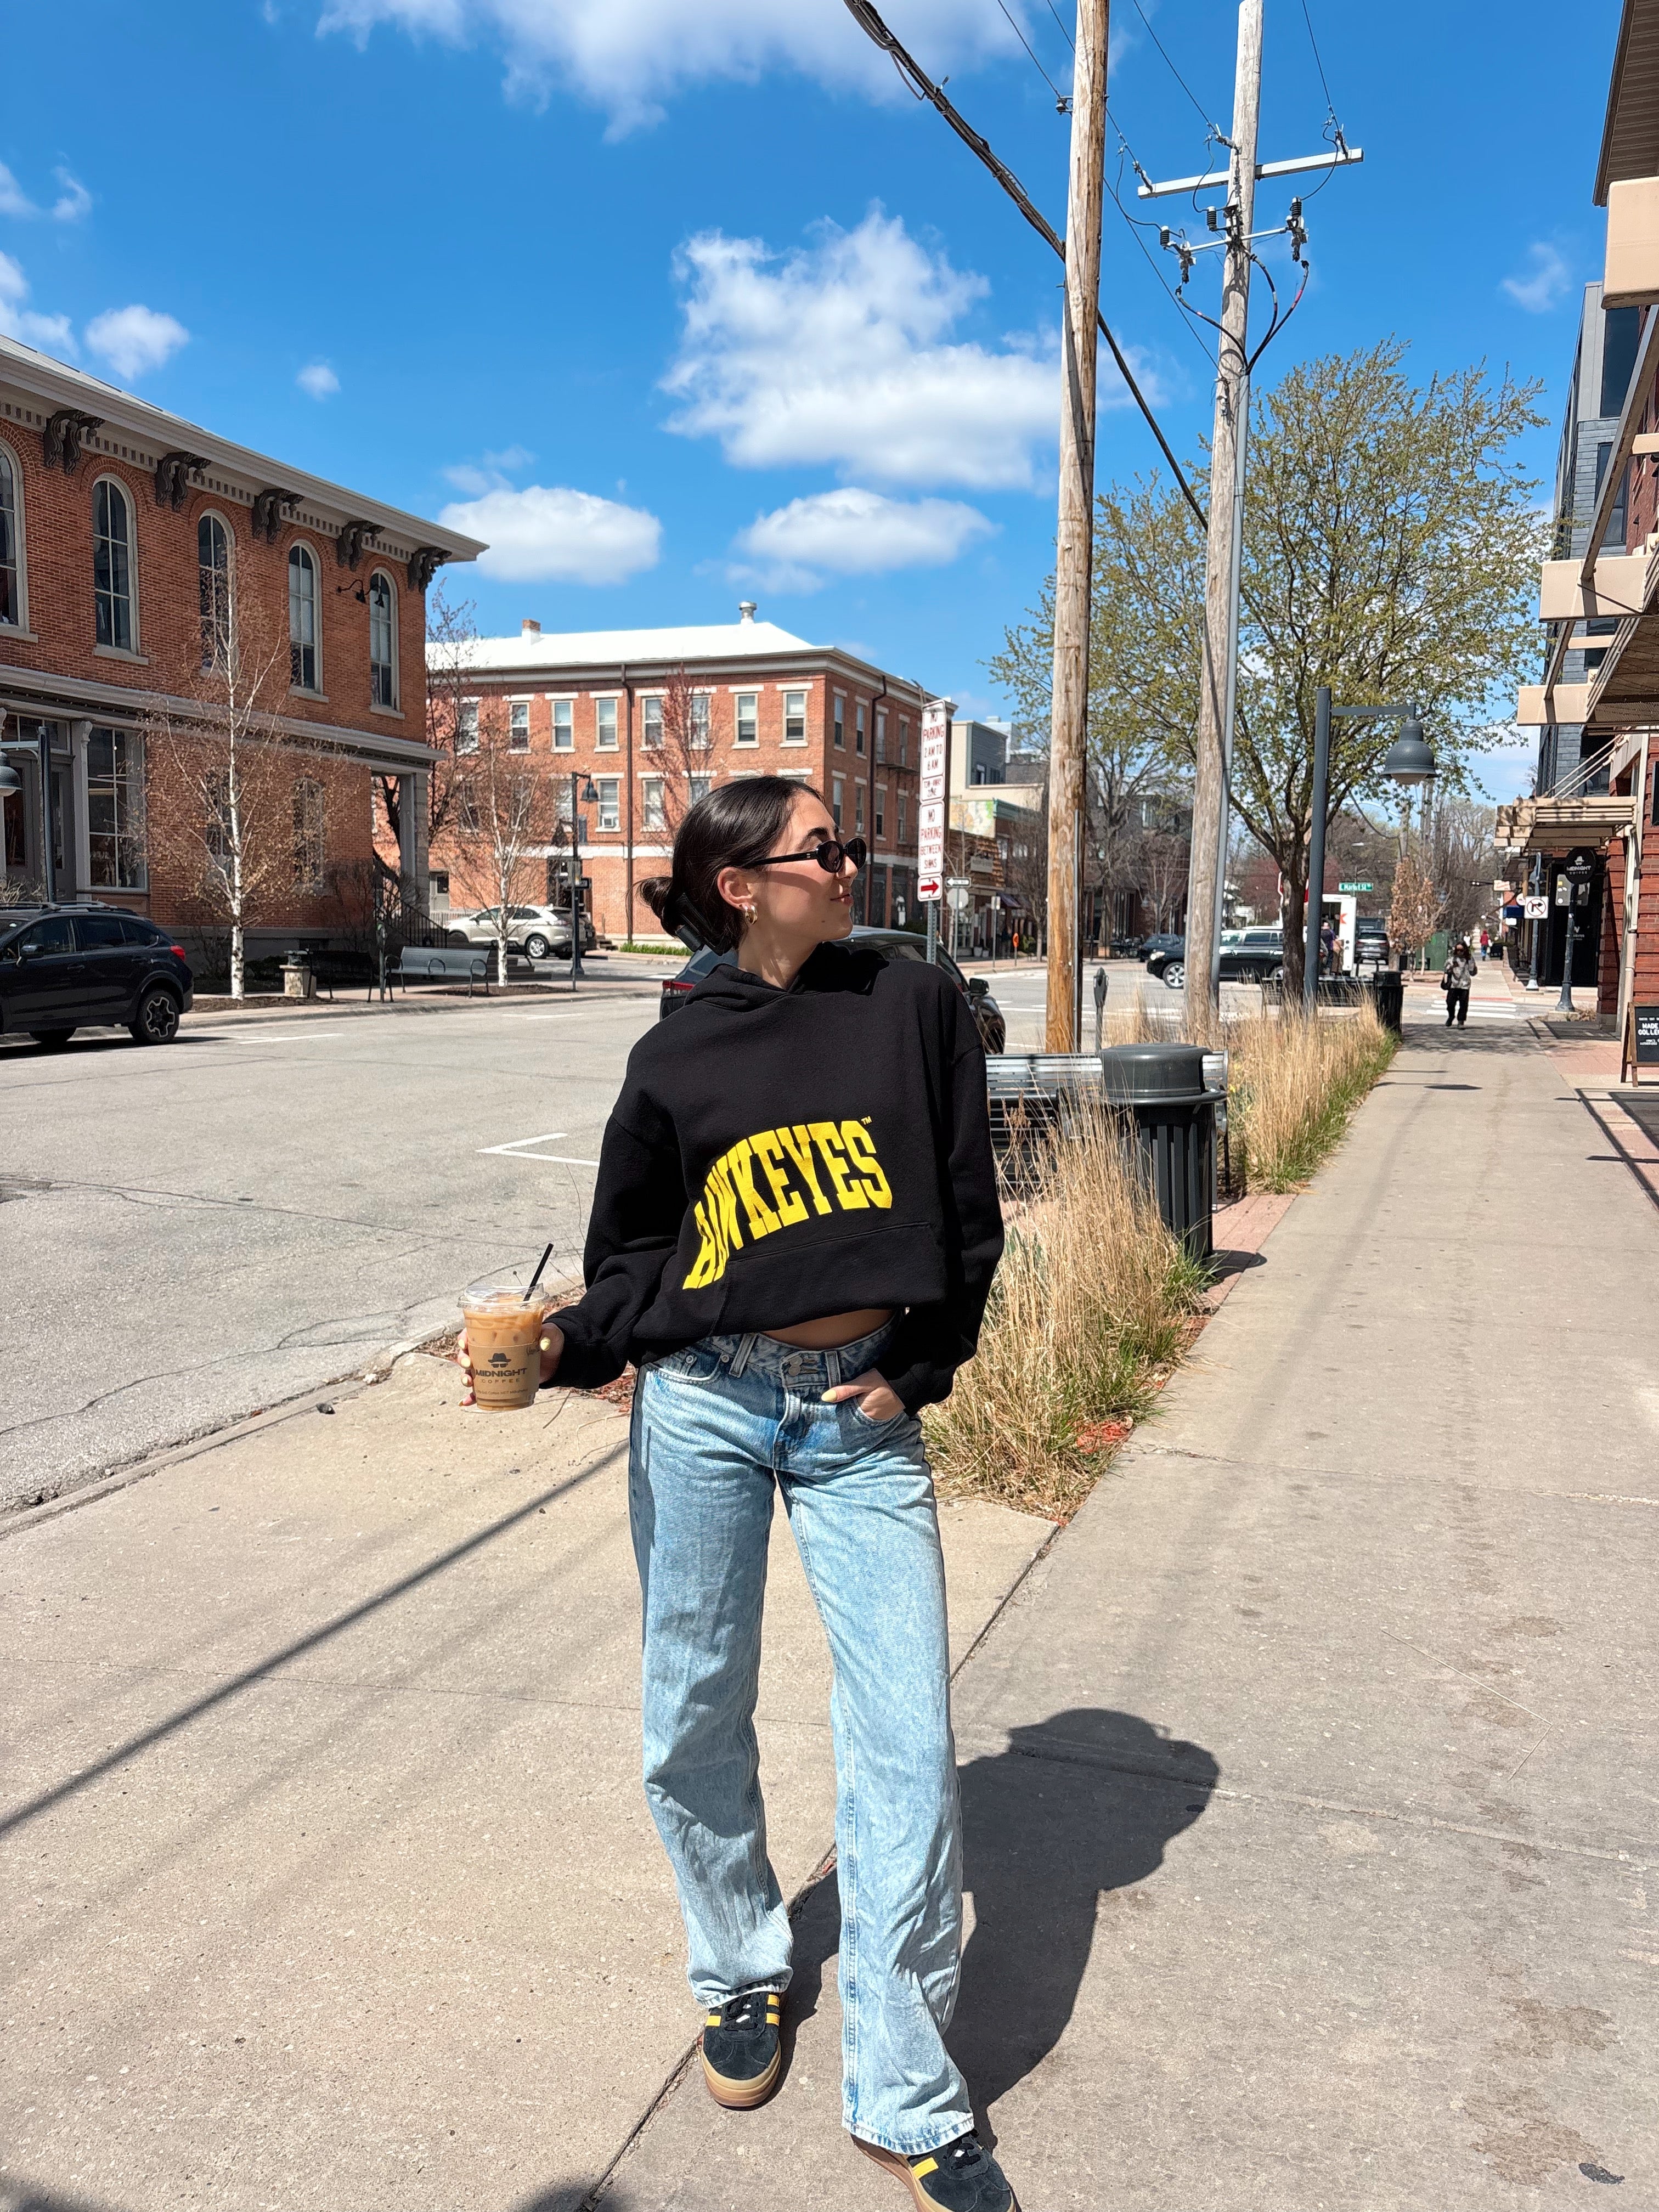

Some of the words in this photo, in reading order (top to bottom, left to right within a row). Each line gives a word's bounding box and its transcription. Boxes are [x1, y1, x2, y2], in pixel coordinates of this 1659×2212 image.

[923, 725, 944, 741] PARKING
[928, 809, 935, 822] NO
[921, 826, 942, 841] PARKING
[921, 844, 941, 856] BETWEEN
[476, 1368, 527, 1377] MIDNIGHT
